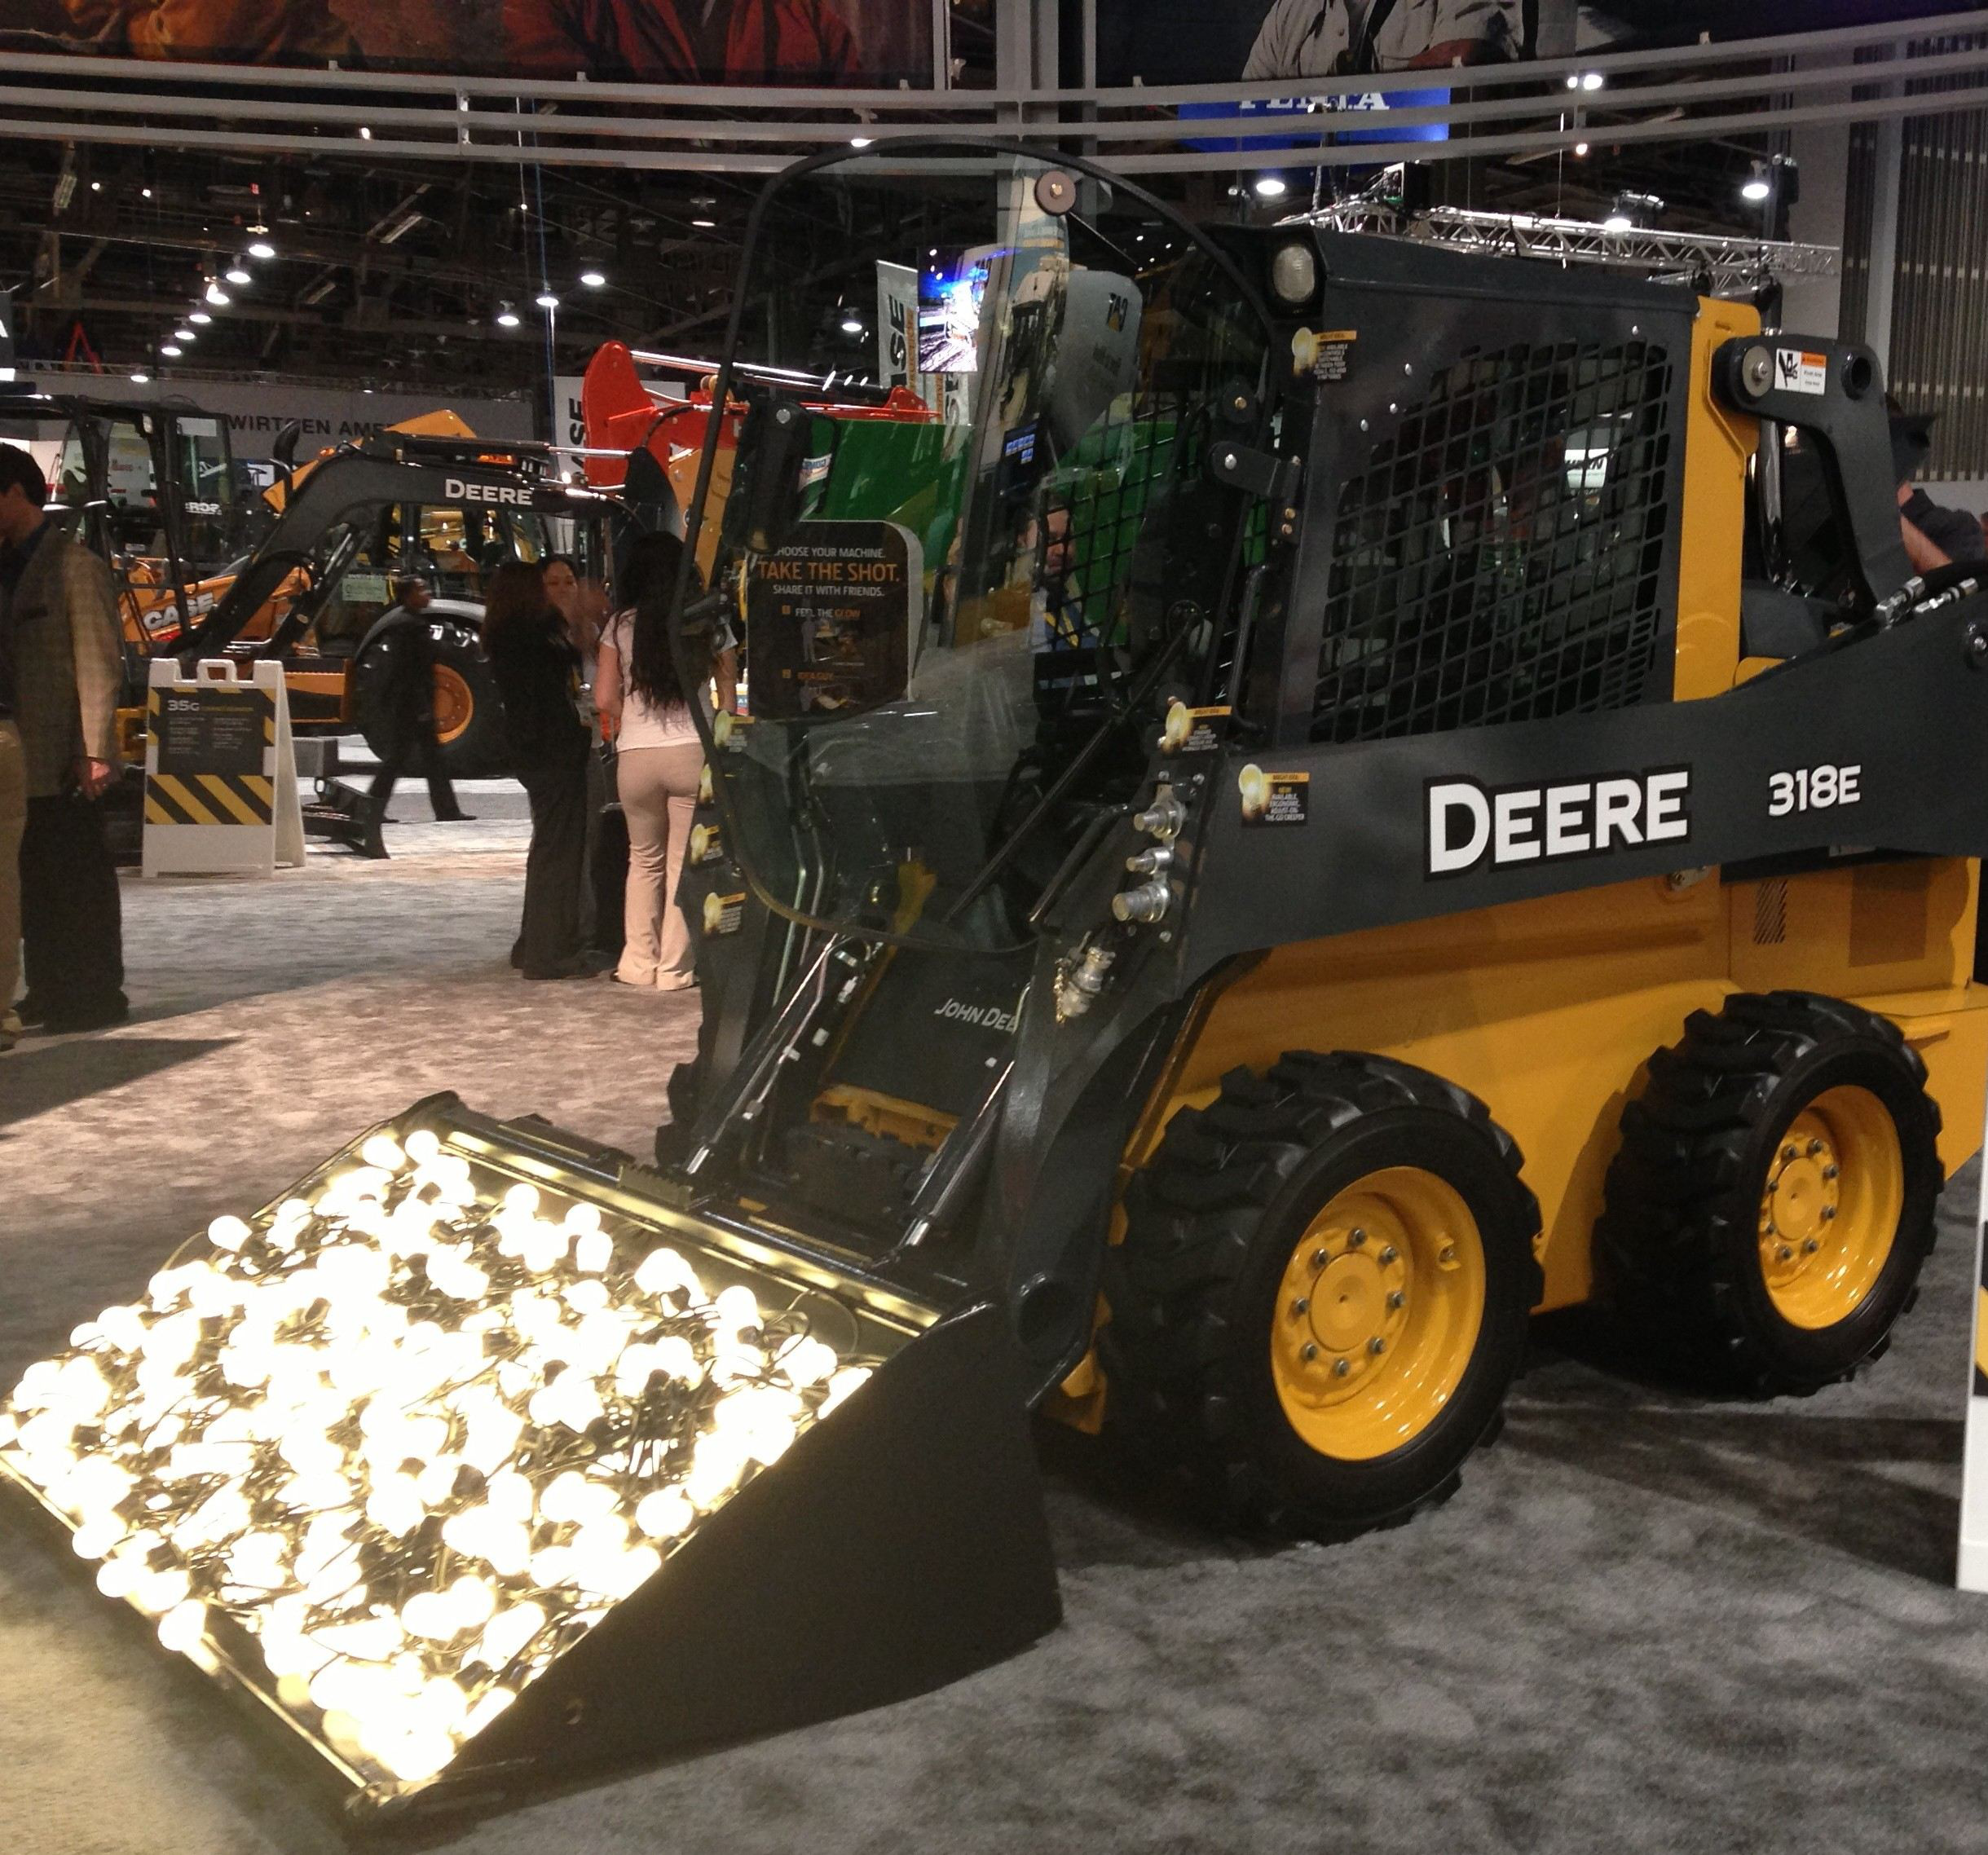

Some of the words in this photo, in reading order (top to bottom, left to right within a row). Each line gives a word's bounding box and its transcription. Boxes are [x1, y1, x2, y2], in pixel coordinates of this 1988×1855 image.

[226, 414, 331, 435] WIRTEN
[445, 478, 533, 505] DEERE
[812, 548, 837, 557] YOUR
[840, 548, 886, 558] MACHINE.
[757, 560, 802, 579] TAKE
[807, 562, 844, 581] THE
[848, 564, 900, 582] SHOT.
[773, 585, 803, 594] SHARE
[805, 585, 814, 594] IT
[816, 586, 841, 595] WITH
[844, 587, 885, 597] FRIENDS.
[818, 609, 833, 618] THE
[1429, 771, 1689, 873] DEERE
[1768, 764, 1862, 817] 318E
[933, 998, 985, 1023] JOHN
[981, 1007, 1018, 1033] DEE
